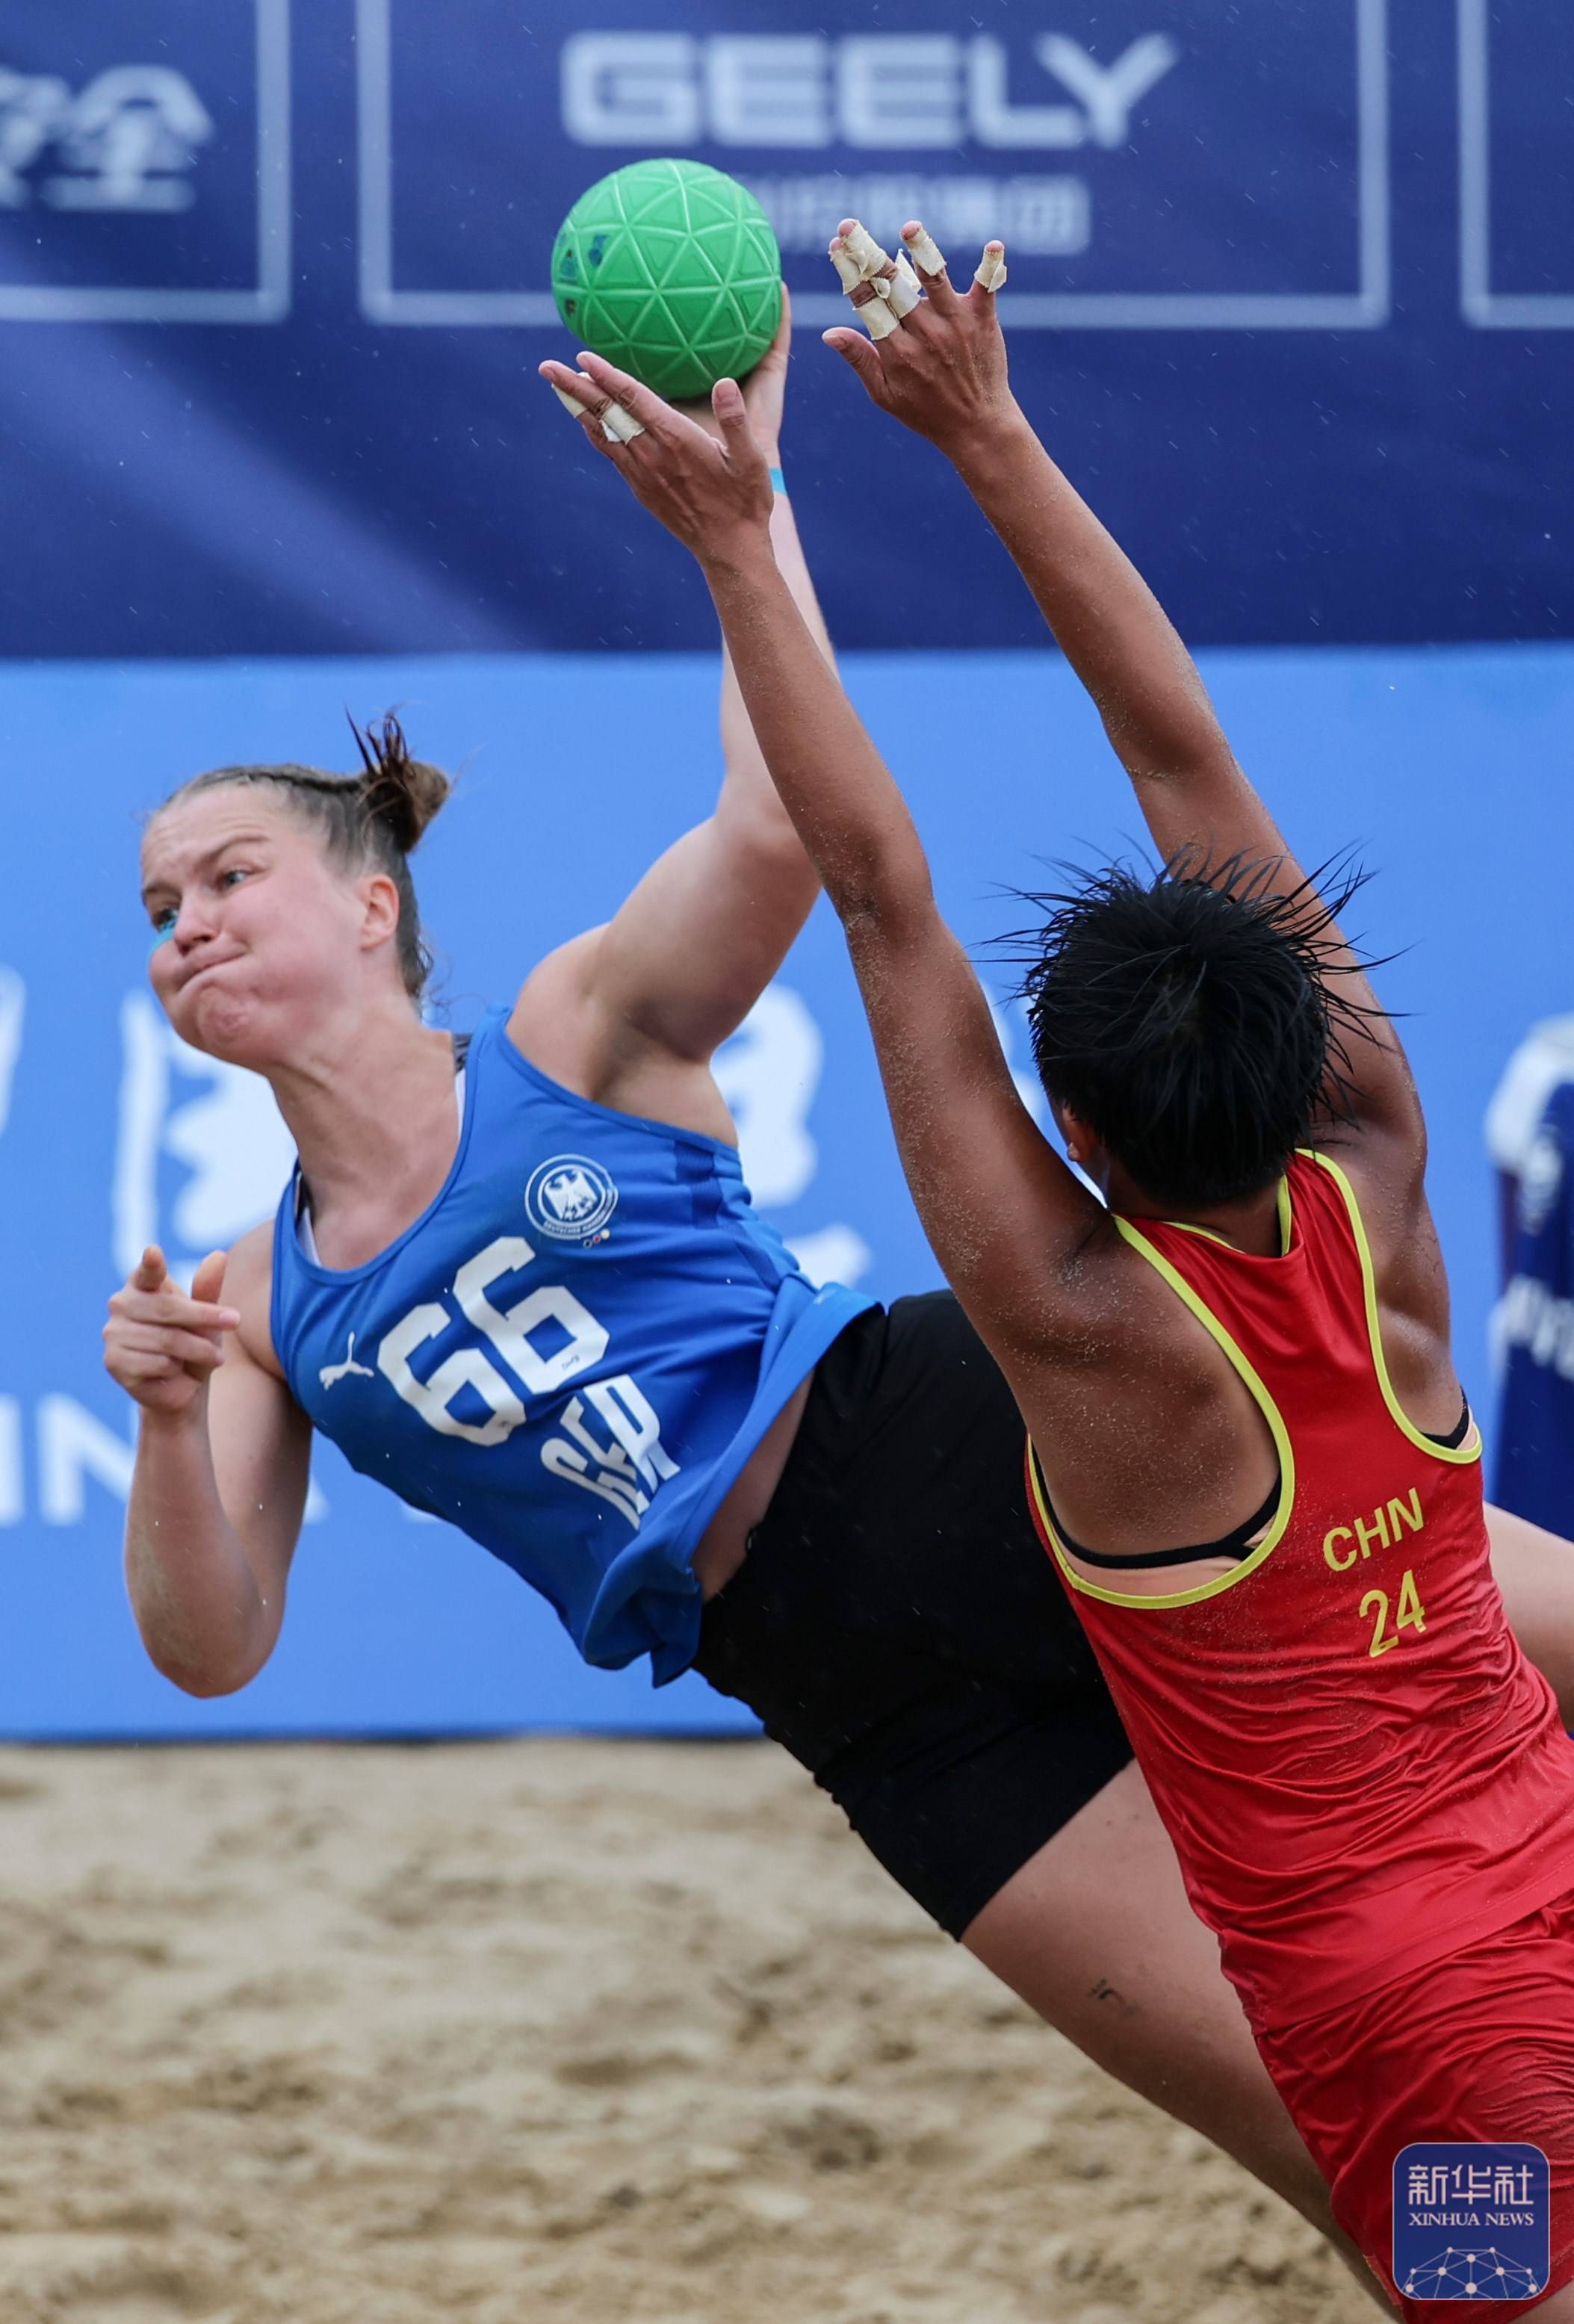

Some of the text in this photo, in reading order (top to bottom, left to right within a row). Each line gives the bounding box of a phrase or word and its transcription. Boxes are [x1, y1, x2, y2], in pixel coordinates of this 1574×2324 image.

[561, 31, 1177, 148] GEELY
[377, 1236, 610, 1447] 66
[540, 1374, 681, 1531] GER
[1322, 1487, 1425, 1572] CHN
[1359, 1569, 1428, 1658] 24
